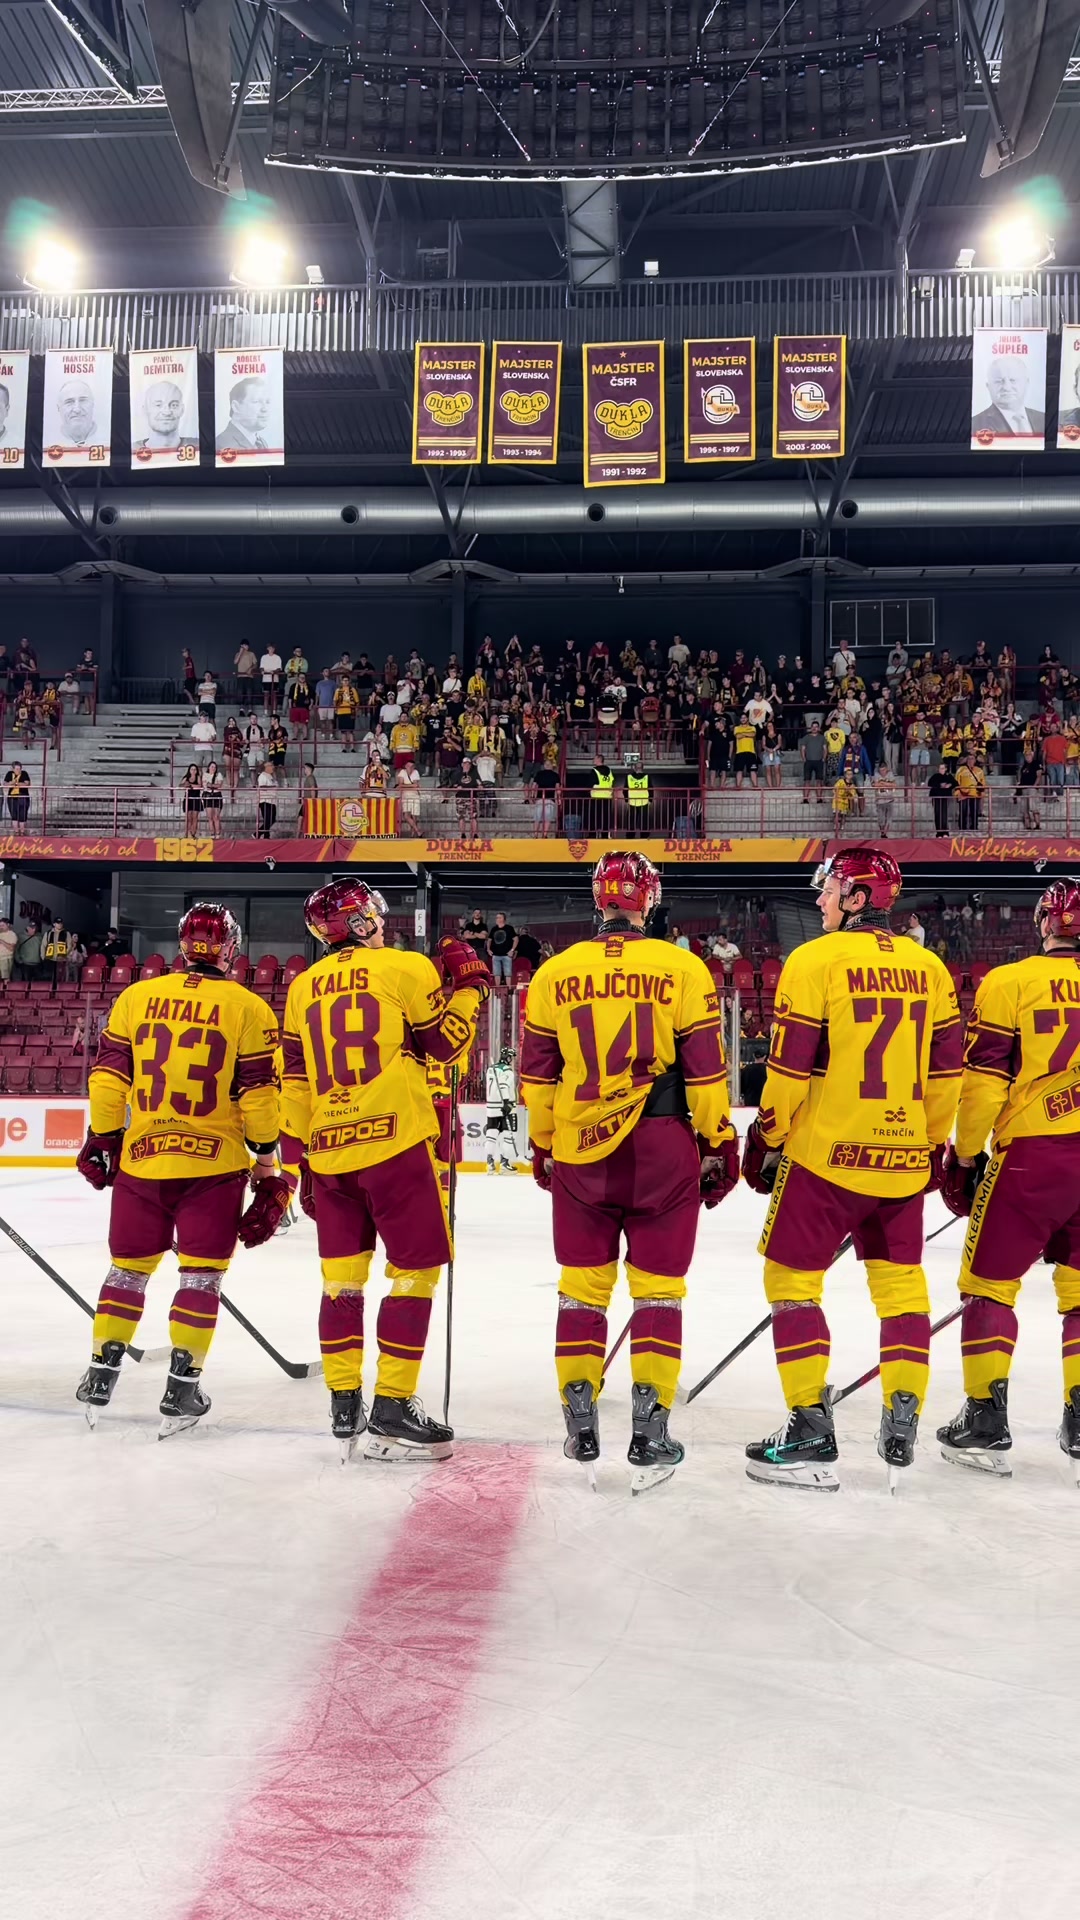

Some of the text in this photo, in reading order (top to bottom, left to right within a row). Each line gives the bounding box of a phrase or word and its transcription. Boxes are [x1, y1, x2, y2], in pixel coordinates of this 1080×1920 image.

[500, 359, 553, 369] MAJSTER
[692, 356, 747, 366] MAJSTER
[782, 353, 838, 363] MAJSTER
[63, 363, 95, 374] HOSSA
[143, 363, 184, 375] DEMITRA
[231, 363, 266, 375] ŠVEHLA
[422, 360, 476, 370] MAJSTER
[591, 362, 655, 375] MAJSTER
[785, 366, 834, 374] SLOVENSKA
[503, 372, 550, 380] SLOVENSKA
[696, 369, 744, 377] SLOVENSKA
[610, 377, 637, 387] ČSFR
[429, 397, 469, 410] DUKLA
[505, 396, 545, 409] DUKLA
[600, 405, 647, 421] DUKLA
[89, 445, 105, 461] 21
[177, 446, 196, 460] 38
[810, 443, 832, 451] 2004
[3, 448, 19, 463] 10
[601, 468, 620, 477] 1991
[626, 467, 647, 476] 1992
[62, 846, 73, 855] u
[79, 839, 108, 856] nás
[117, 838, 139, 855] od
[154, 838, 214, 861] 1962
[426, 839, 494, 852] DUKLA
[664, 839, 733, 852] DUKLA
[950, 837, 1039, 861] Najlepšia
[1046, 847, 1059, 856] u
[437, 850, 482, 861] TRENČÍN
[675, 850, 721, 861] TRENČÍN
[604, 880, 619, 894] 14
[193, 942, 207, 953] 33
[311, 968, 369, 998] KALIS
[555, 968, 674, 1006] KRAJČOVIČ
[846, 967, 928, 995] MARUNA
[144, 997, 220, 1027] HATALA
[439, 1014, 469, 1050] 18
[305, 992, 383, 1096] 18
[852, 997, 927, 1101] 71
[570, 1002, 657, 1101] 14
[135, 1022, 228, 1117] 33
[321, 1119, 391, 1147] TIPOS
[872, 1128, 915, 1137] TRENČÍN
[45, 1138, 80, 1148] orange
[151, 1134, 215, 1156] TIPOS
[866, 1148, 930, 1169] TIPOS
[968, 1161, 999, 1244] KERAMING
